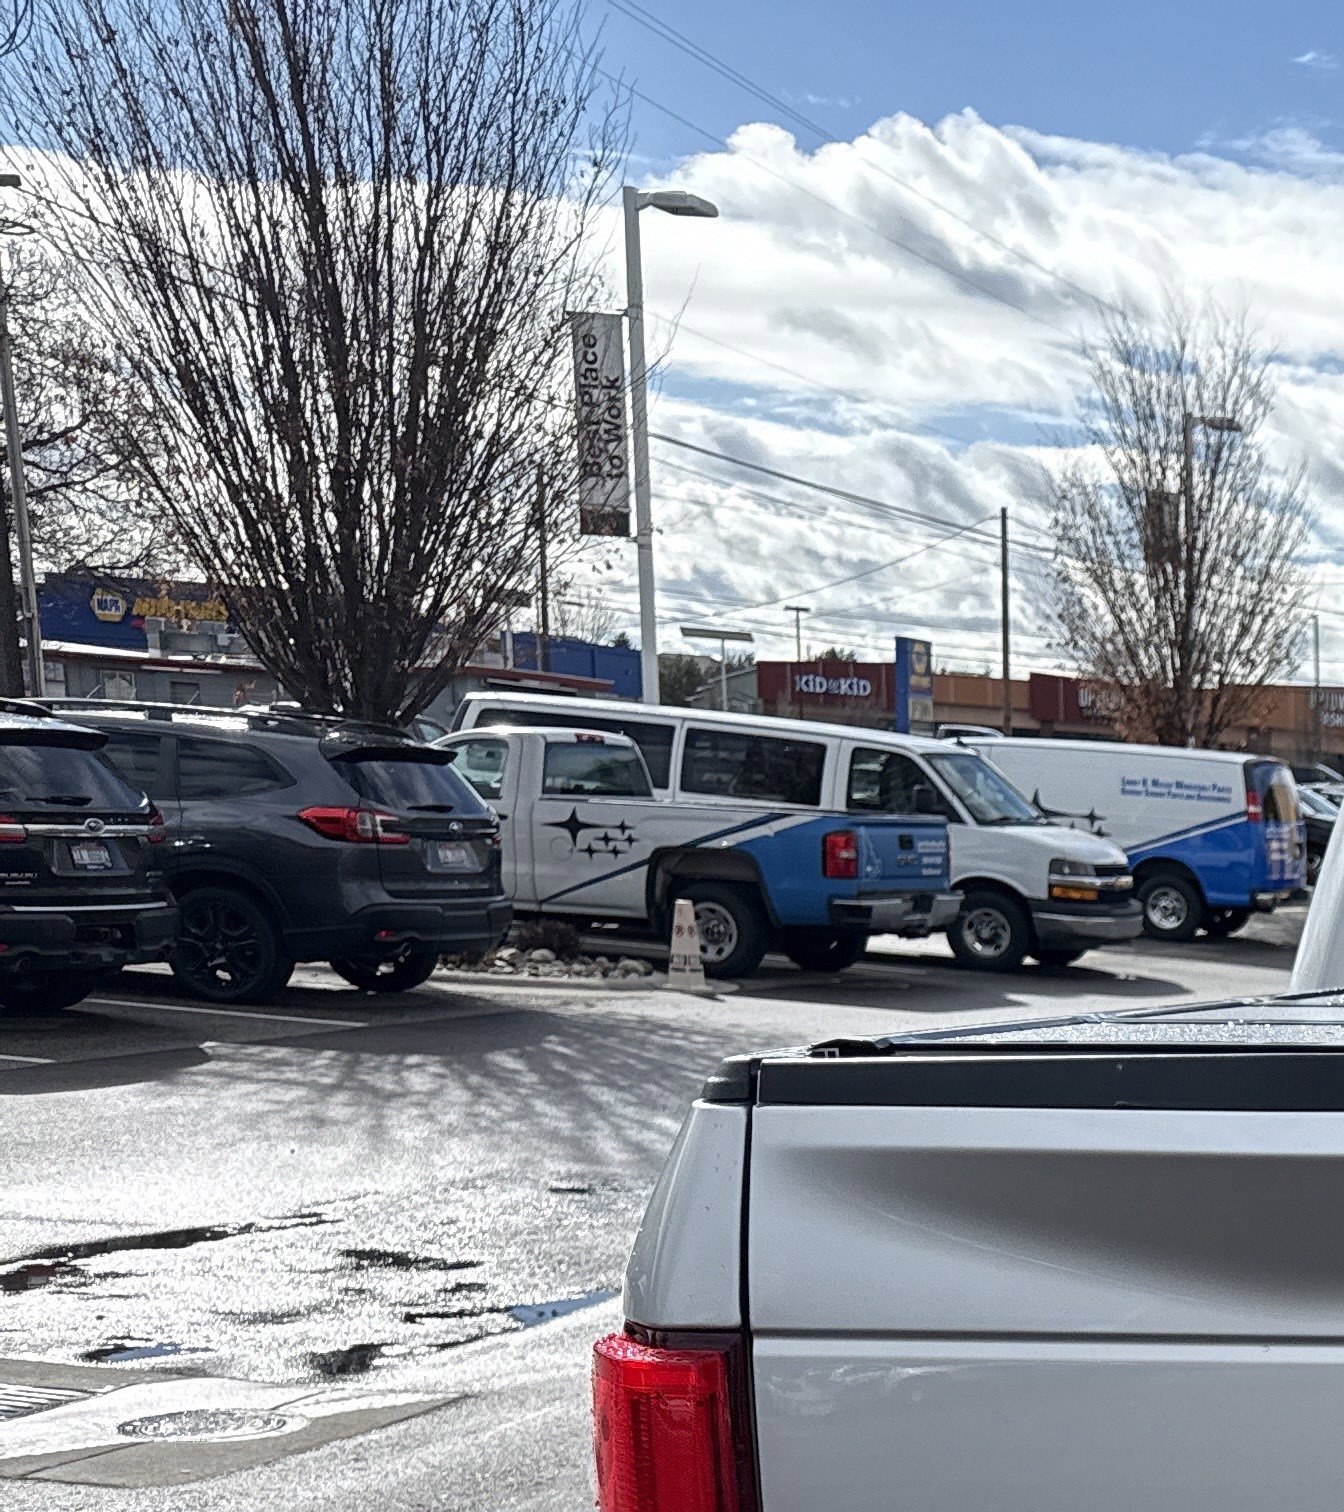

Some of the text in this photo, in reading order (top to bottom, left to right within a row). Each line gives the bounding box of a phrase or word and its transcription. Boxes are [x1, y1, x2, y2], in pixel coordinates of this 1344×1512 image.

[580, 333, 599, 406] Place
[601, 375, 624, 480] to Work
